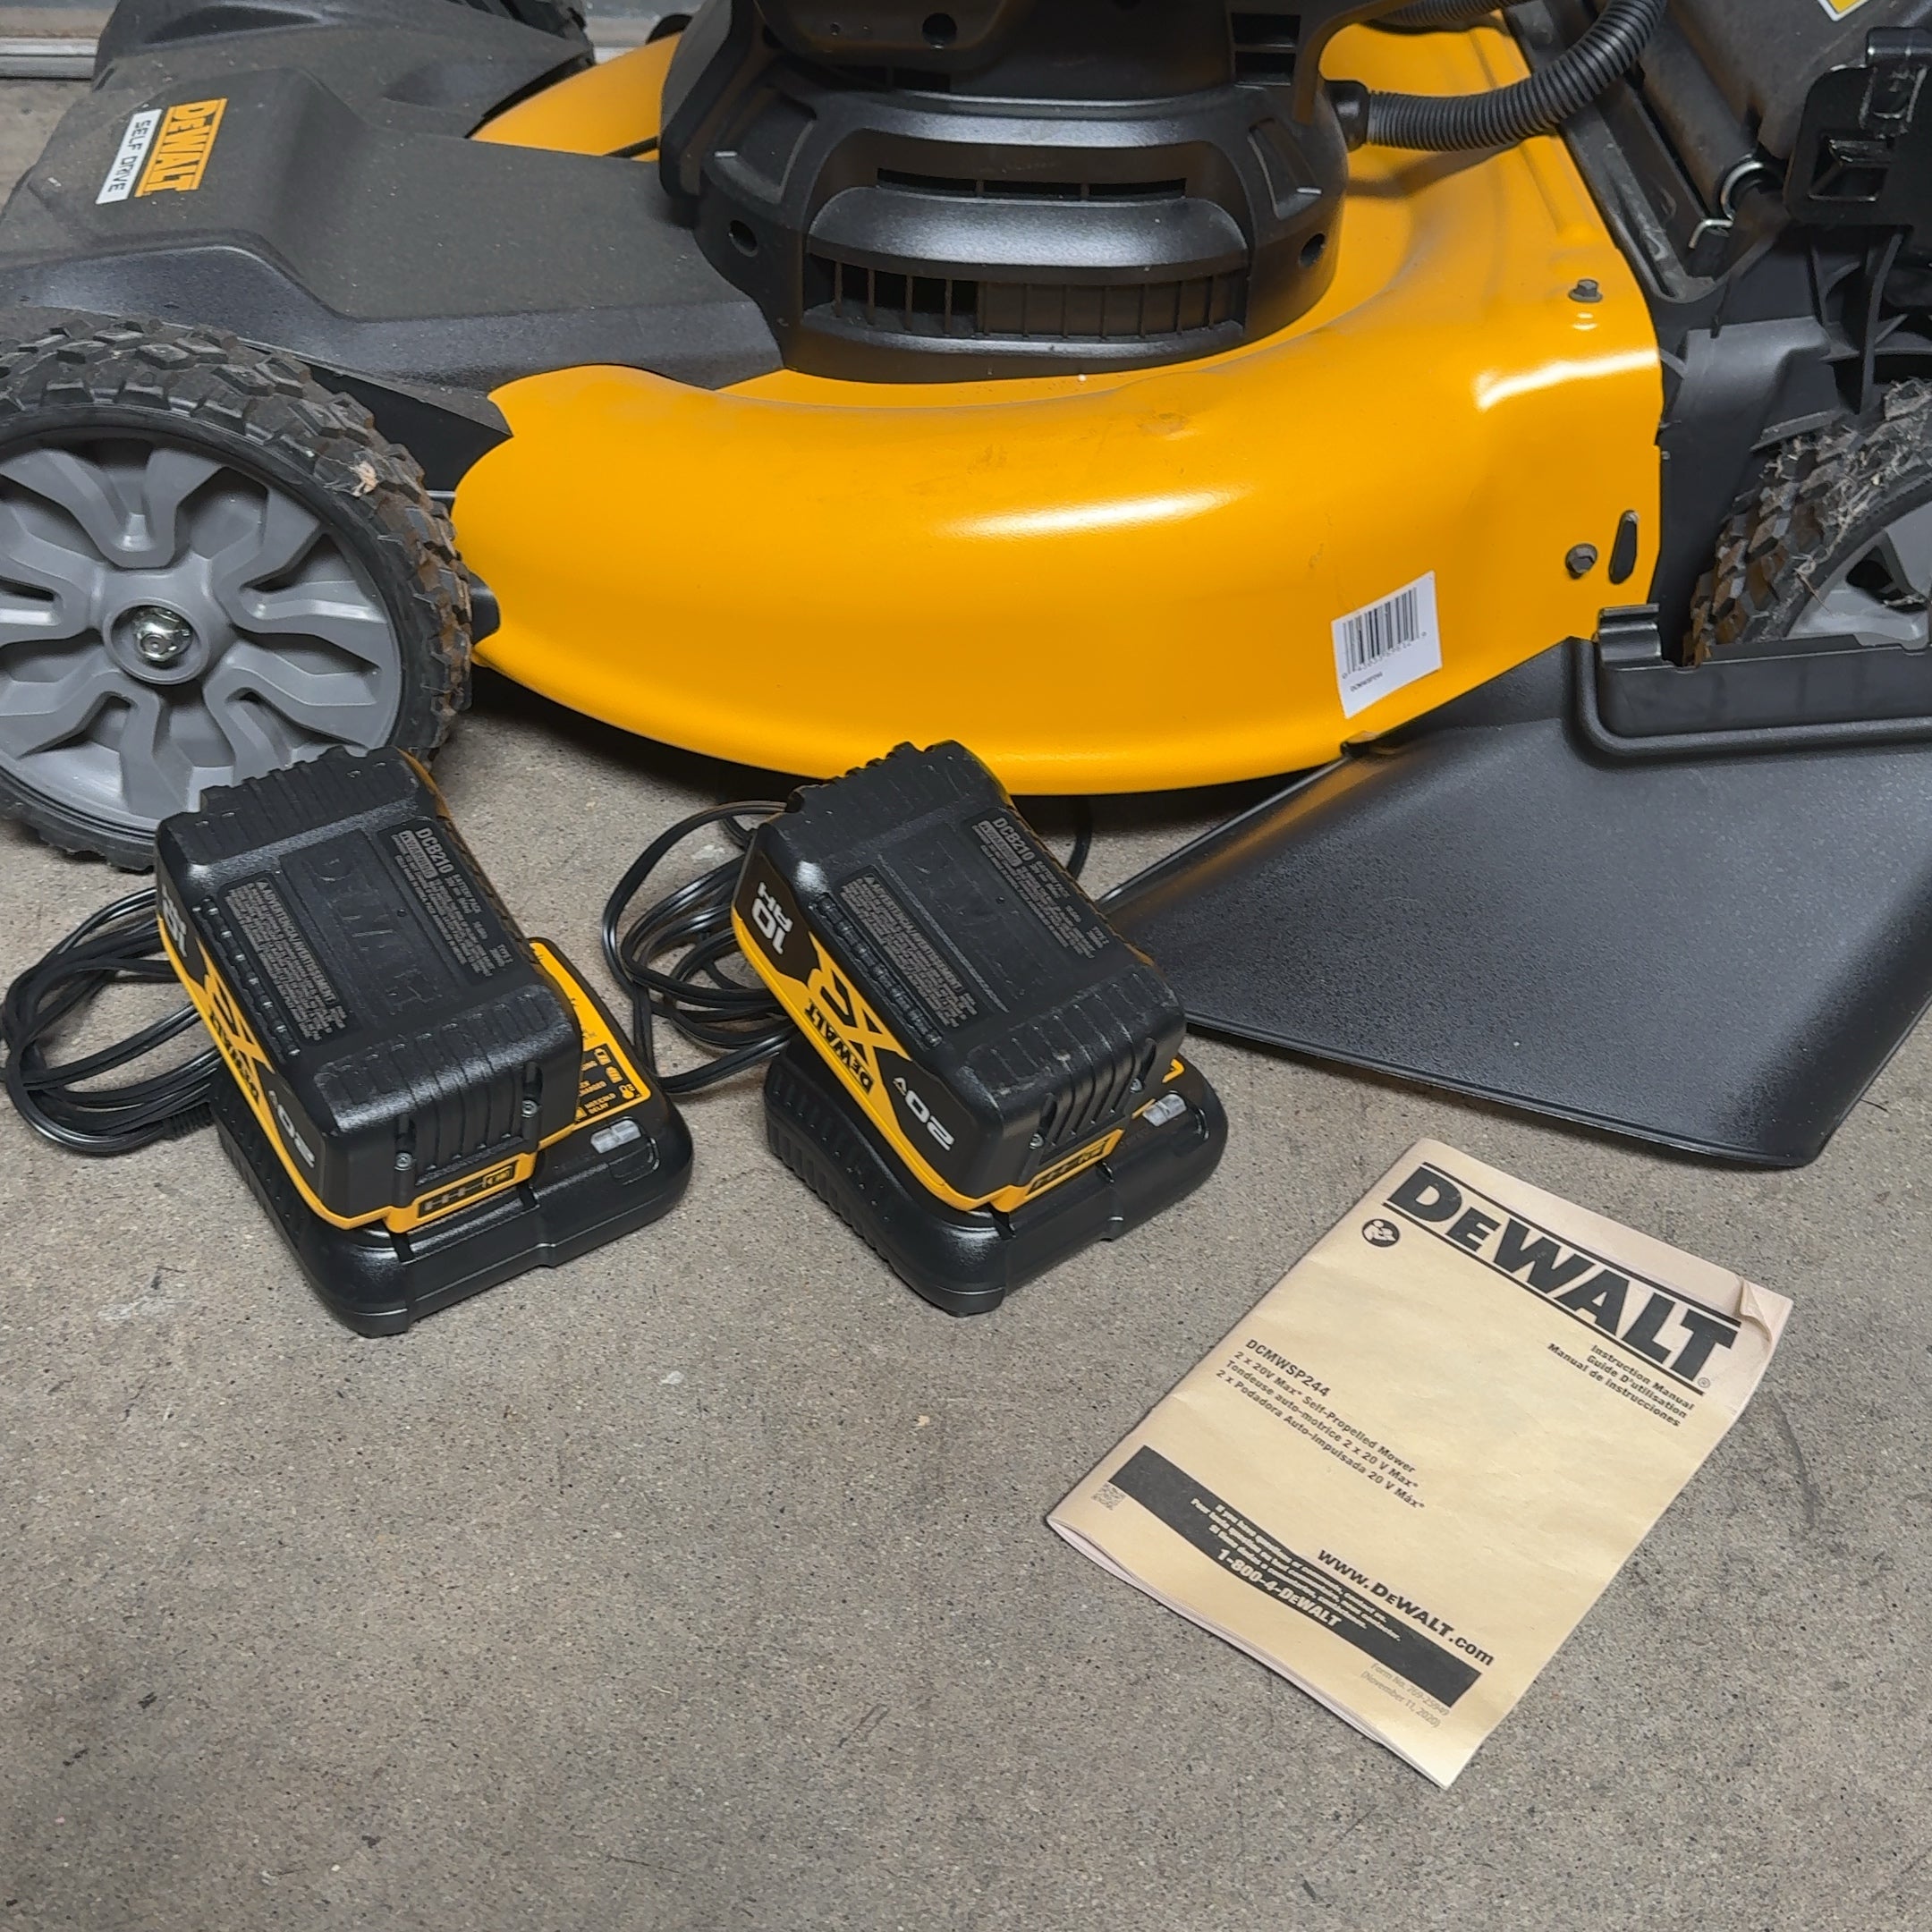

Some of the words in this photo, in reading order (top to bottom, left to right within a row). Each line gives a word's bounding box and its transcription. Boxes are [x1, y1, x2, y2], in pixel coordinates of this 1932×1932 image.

[125, 119, 152, 150] SELF
[143, 98, 218, 191] DEWALT
[107, 155, 138, 191] DRIVE
[414, 825, 454, 875] DCB210
[991, 815, 1036, 862] DCB210
[751, 898, 784, 955] 10
[805, 998, 875, 1096] DEWALT
[1386, 1166, 1738, 1382] DEWALT
[1245, 1338, 1332, 1396] DCMWSP244
[1546, 1343, 1589, 1371] Manual
[1588, 1368, 1605, 1381] de
[1605, 1378, 1682, 1428] instrucciones
[1586, 1354, 1619, 1377] Guide
[1619, 1374, 1688, 1418] D'utilisation
[1590, 1344, 1652, 1385] Instruction
[1651, 1381, 1695, 1411] Manual
[1216, 1368, 1226, 1378] 2
[1225, 1376, 1234, 1384] x
[1233, 1380, 1284, 1417] Podadora
[1282, 1414, 1367, 1474] Auto-Impulsada
[1367, 1470, 1385, 1484] 20
[1384, 1480, 1394, 1489] V
[1224, 1360, 1275, 1395] Tondeuse
[1274, 1394, 1343, 1441] auto-motrice
[1342, 1438, 1352, 1448] 2
[1352, 1446, 1361, 1454] x
[1360, 1451, 1378, 1464] 20
[1378, 1461, 1389, 1470] V
[1233, 1351, 1244, 1360] 2
[1242, 1357, 1252, 1365] x
[1250, 1361, 1275, 1379] 20V
[1301, 1395, 1378, 1448] Self-Propelled
[1377, 1445, 1416, 1473] Mower
[1360, 1670, 1405, 1702] (November
[1370, 1662, 1394, 1681] Form
[1391, 1675, 1407, 1689] No.
